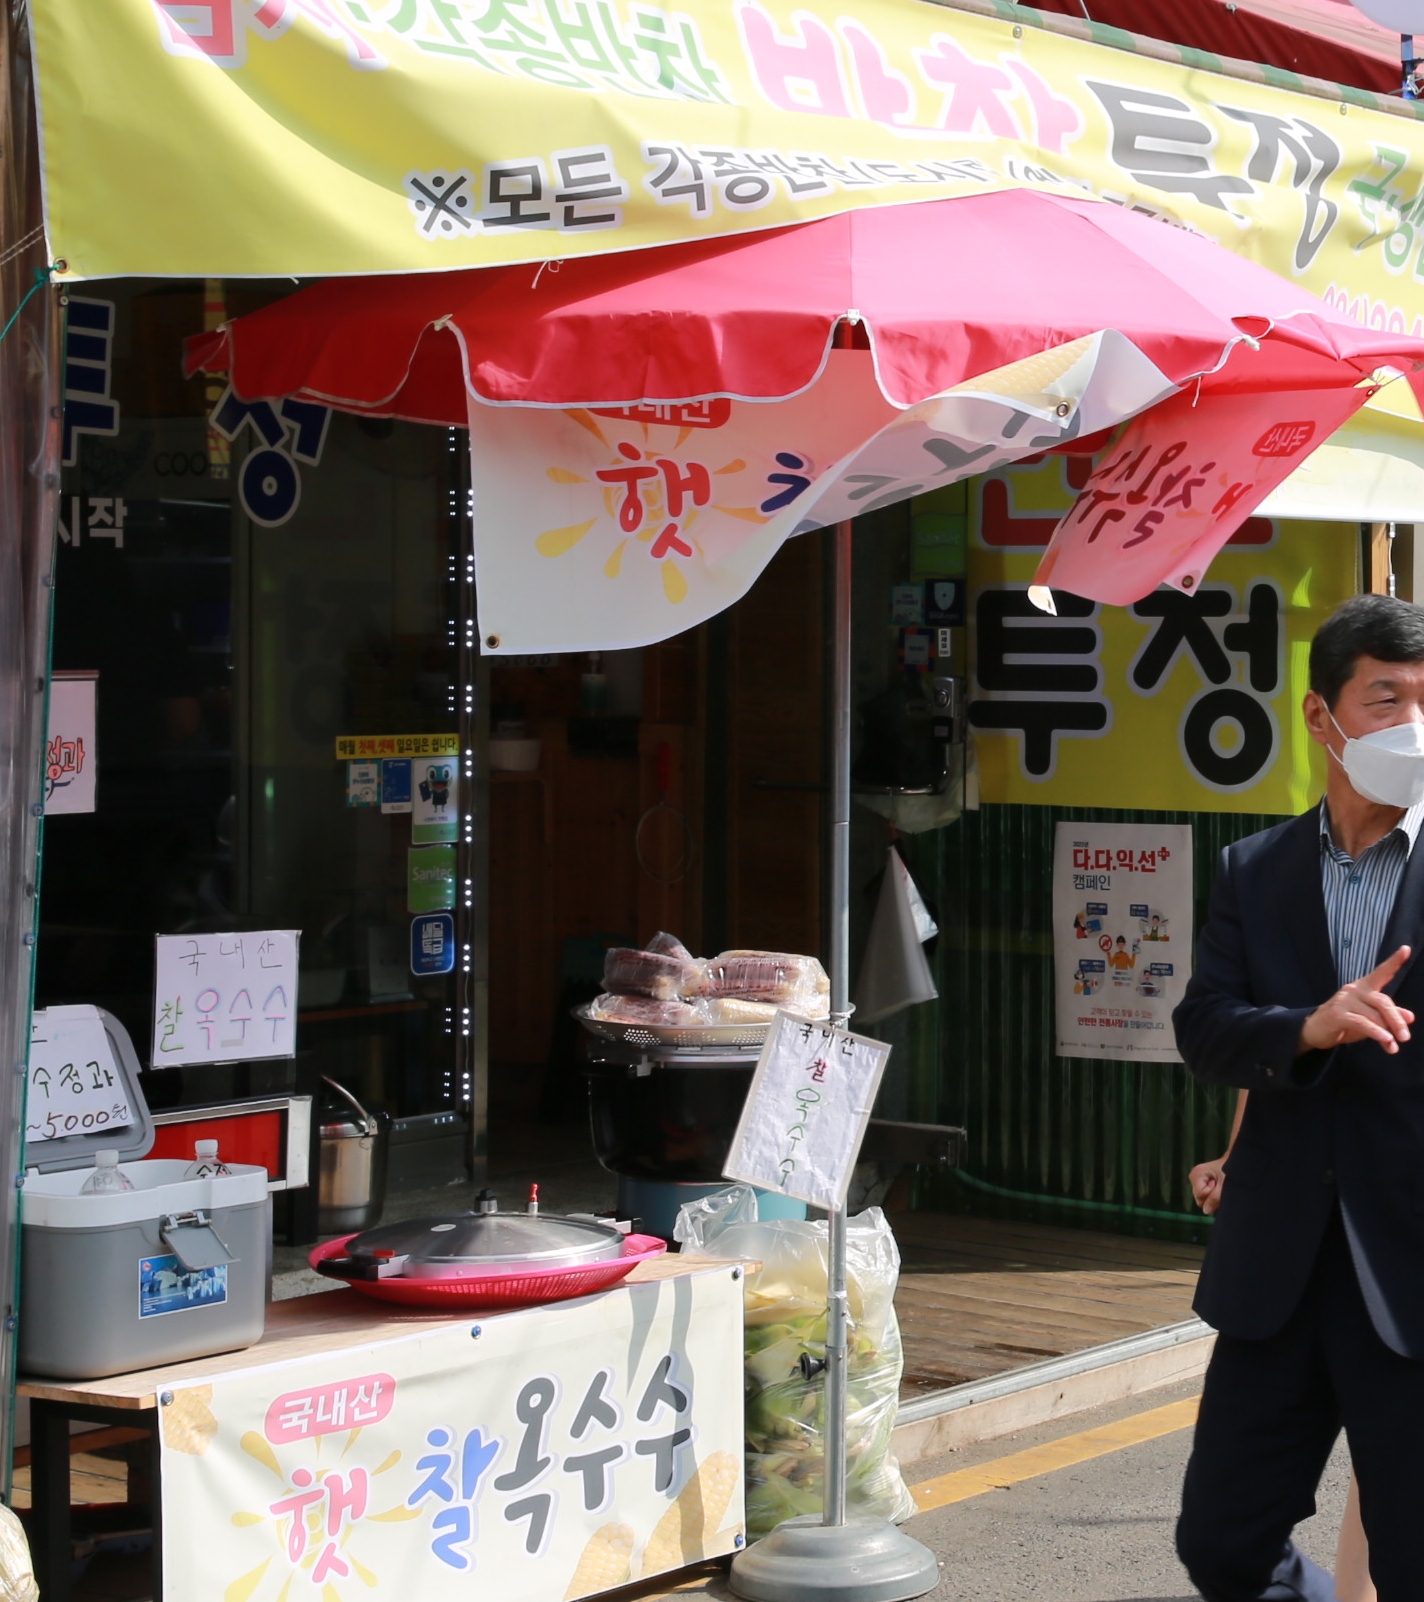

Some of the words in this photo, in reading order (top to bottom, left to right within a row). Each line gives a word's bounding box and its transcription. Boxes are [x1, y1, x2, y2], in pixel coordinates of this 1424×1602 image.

[1086, 80, 1340, 270] 투정
[597, 442, 711, 559] 햇
[969, 585, 1278, 786] 투정
[412, 867, 453, 881] Sanitec
[1073, 874, 1111, 890] 캠페인
[33, 1060, 114, 1098] 수정과
[279, 1381, 382, 1433] 국내산
[270, 1468, 368, 1583] 햇
